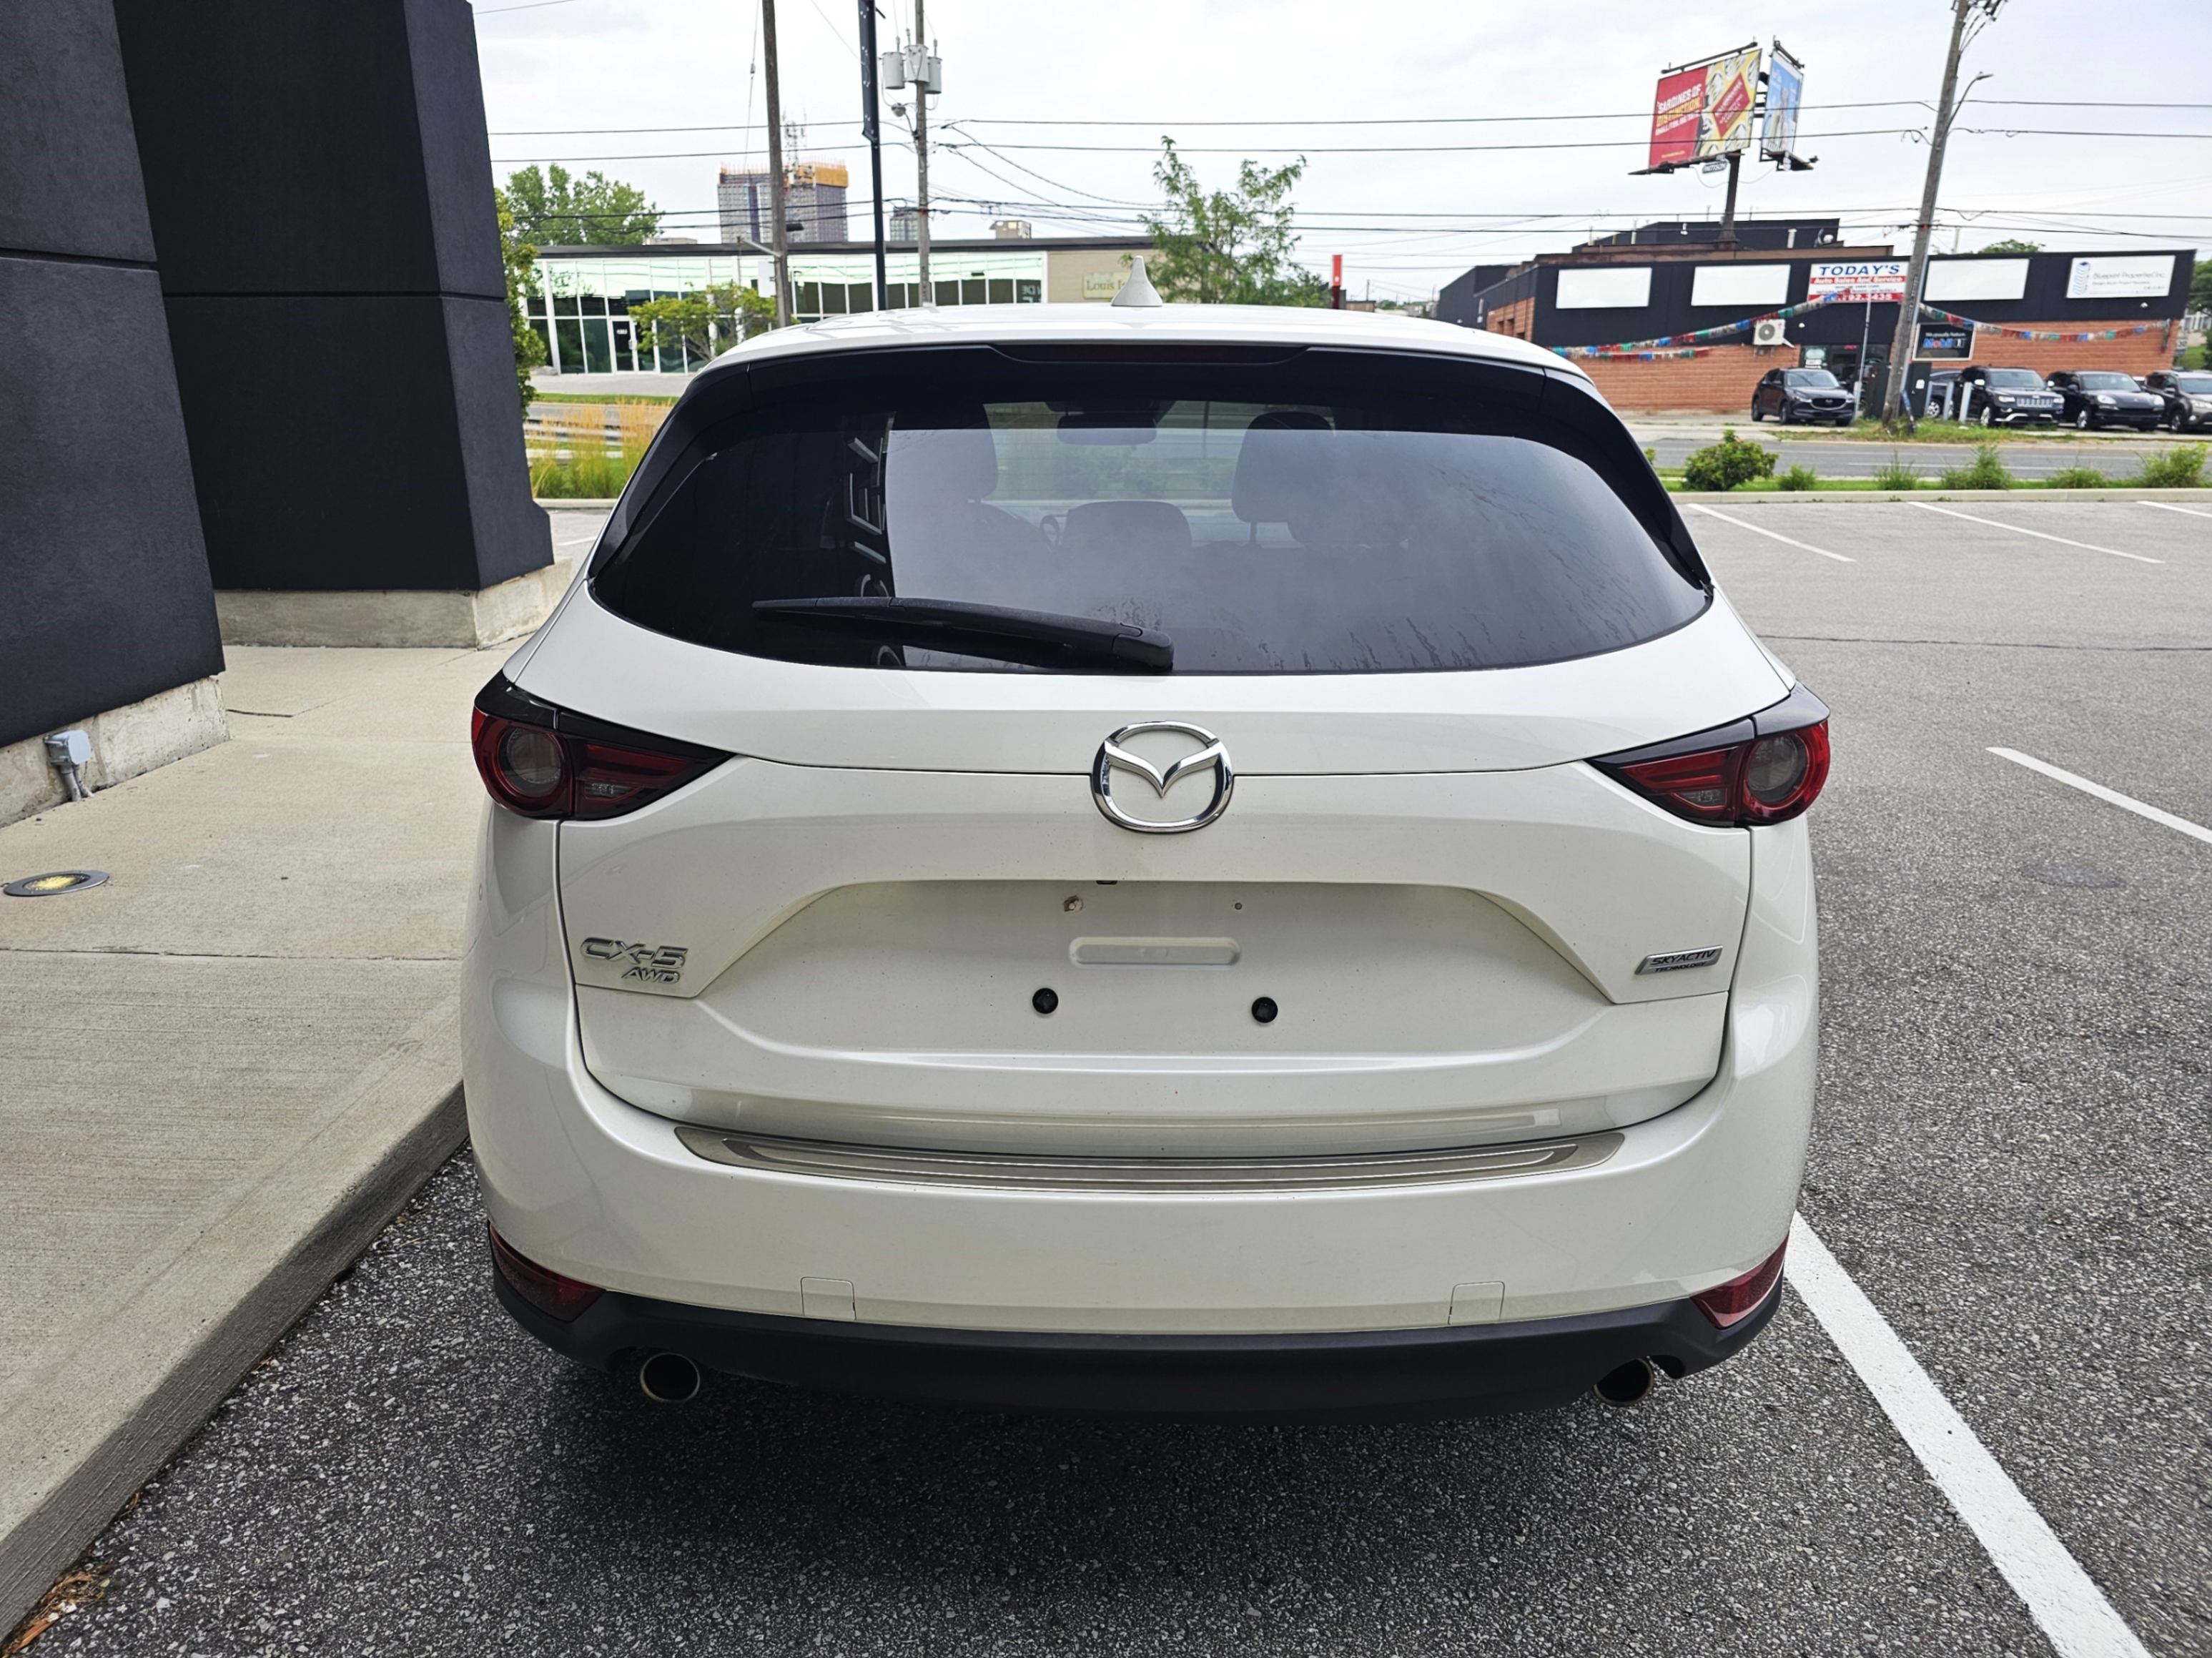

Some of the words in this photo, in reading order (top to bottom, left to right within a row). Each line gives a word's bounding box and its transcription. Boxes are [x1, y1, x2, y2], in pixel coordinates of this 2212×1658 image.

[1820, 265, 1900, 276] TODAY'S
[1087, 280, 1115, 291] Louis
[1923, 338, 1953, 348] Mobil
[579, 937, 688, 969] CX-5
[1651, 949, 1717, 965] SKYACTIV
[1654, 962, 1707, 973] TECHNOLOGY
[621, 967, 681, 985] AWD
